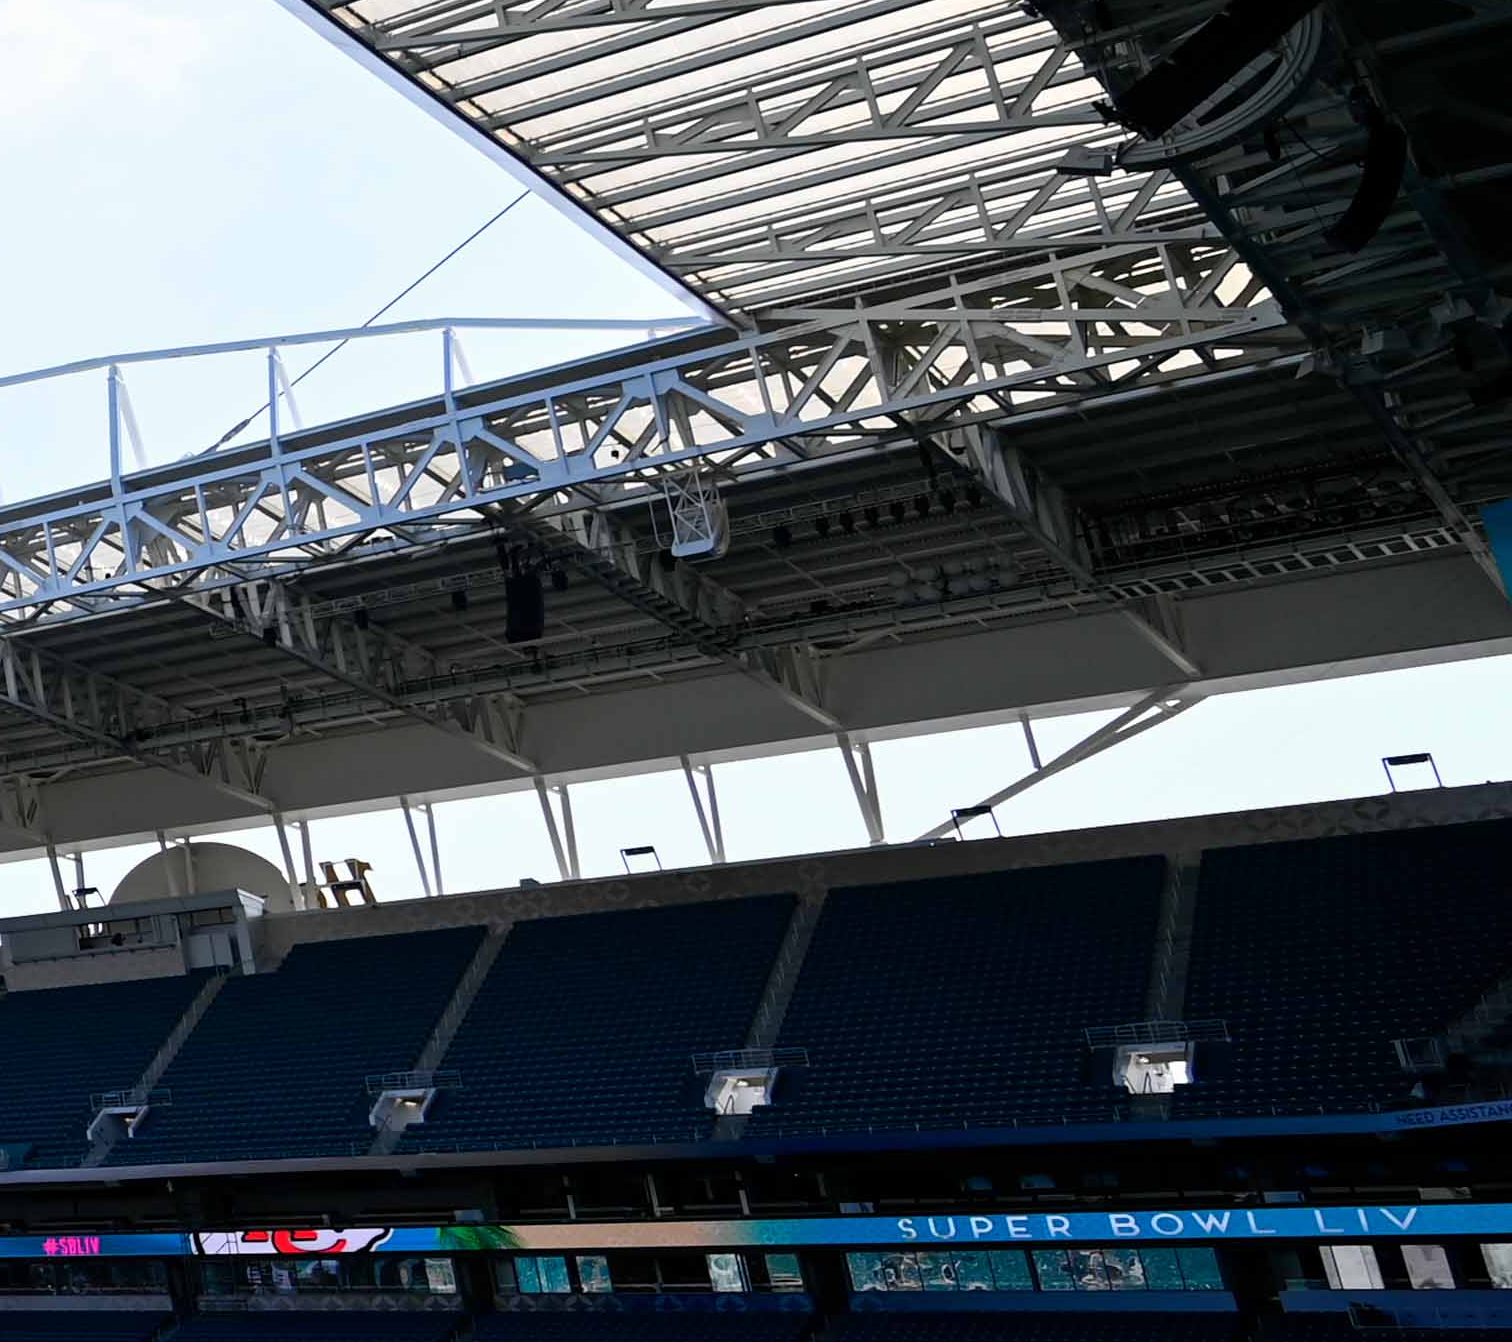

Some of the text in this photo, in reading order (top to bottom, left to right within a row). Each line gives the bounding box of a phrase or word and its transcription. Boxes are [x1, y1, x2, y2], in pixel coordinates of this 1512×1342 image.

[897, 1206, 1419, 1243] SUPER BOWL LIV
